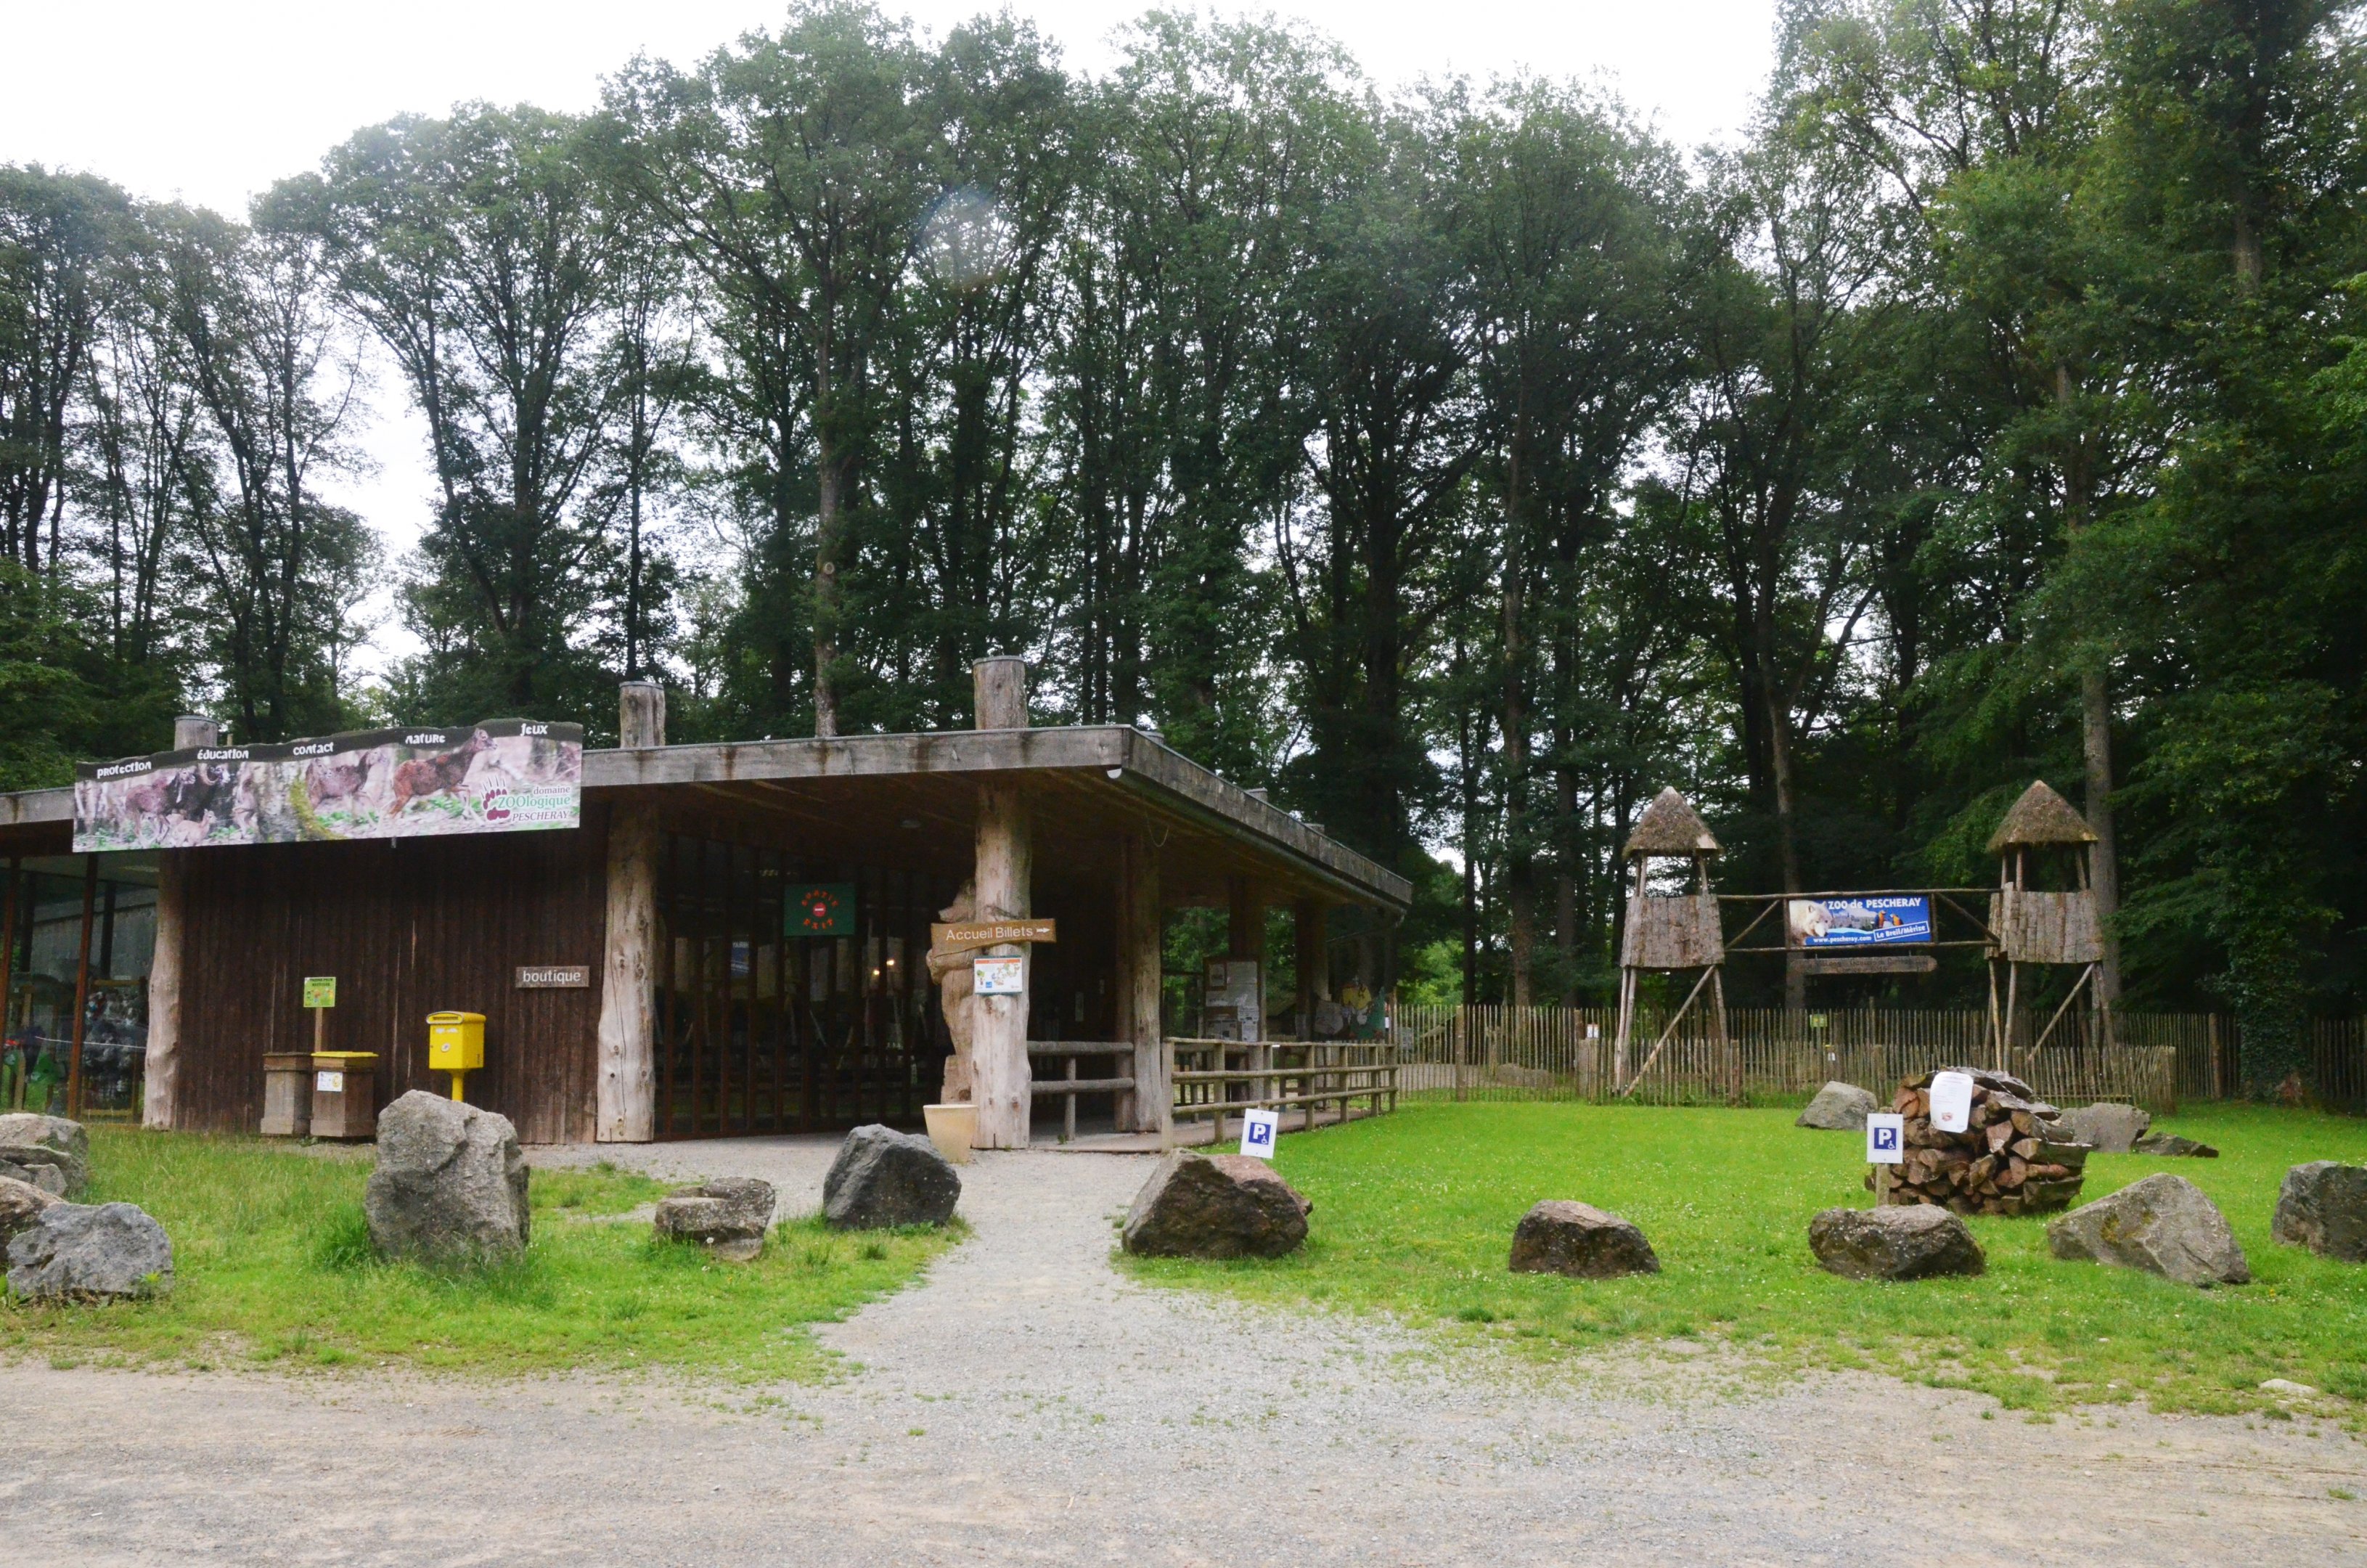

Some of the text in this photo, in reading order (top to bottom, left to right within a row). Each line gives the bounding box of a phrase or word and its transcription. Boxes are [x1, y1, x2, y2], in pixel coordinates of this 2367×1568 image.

[293, 742, 334, 756] contact
[534, 786, 571, 795] domaine
[498, 796, 571, 809] ZOOlogique
[512, 811, 570, 821] PESCHERAY
[1828, 897, 1922, 910] ZOO de PESCHERAY
[946, 926, 1034, 941] Accueil Billets
[1813, 935, 1872, 944] www.pescheray.com
[523, 970, 581, 985] boutique
[1253, 1124, 1267, 1140] P
[1879, 1129, 1892, 1146] P
